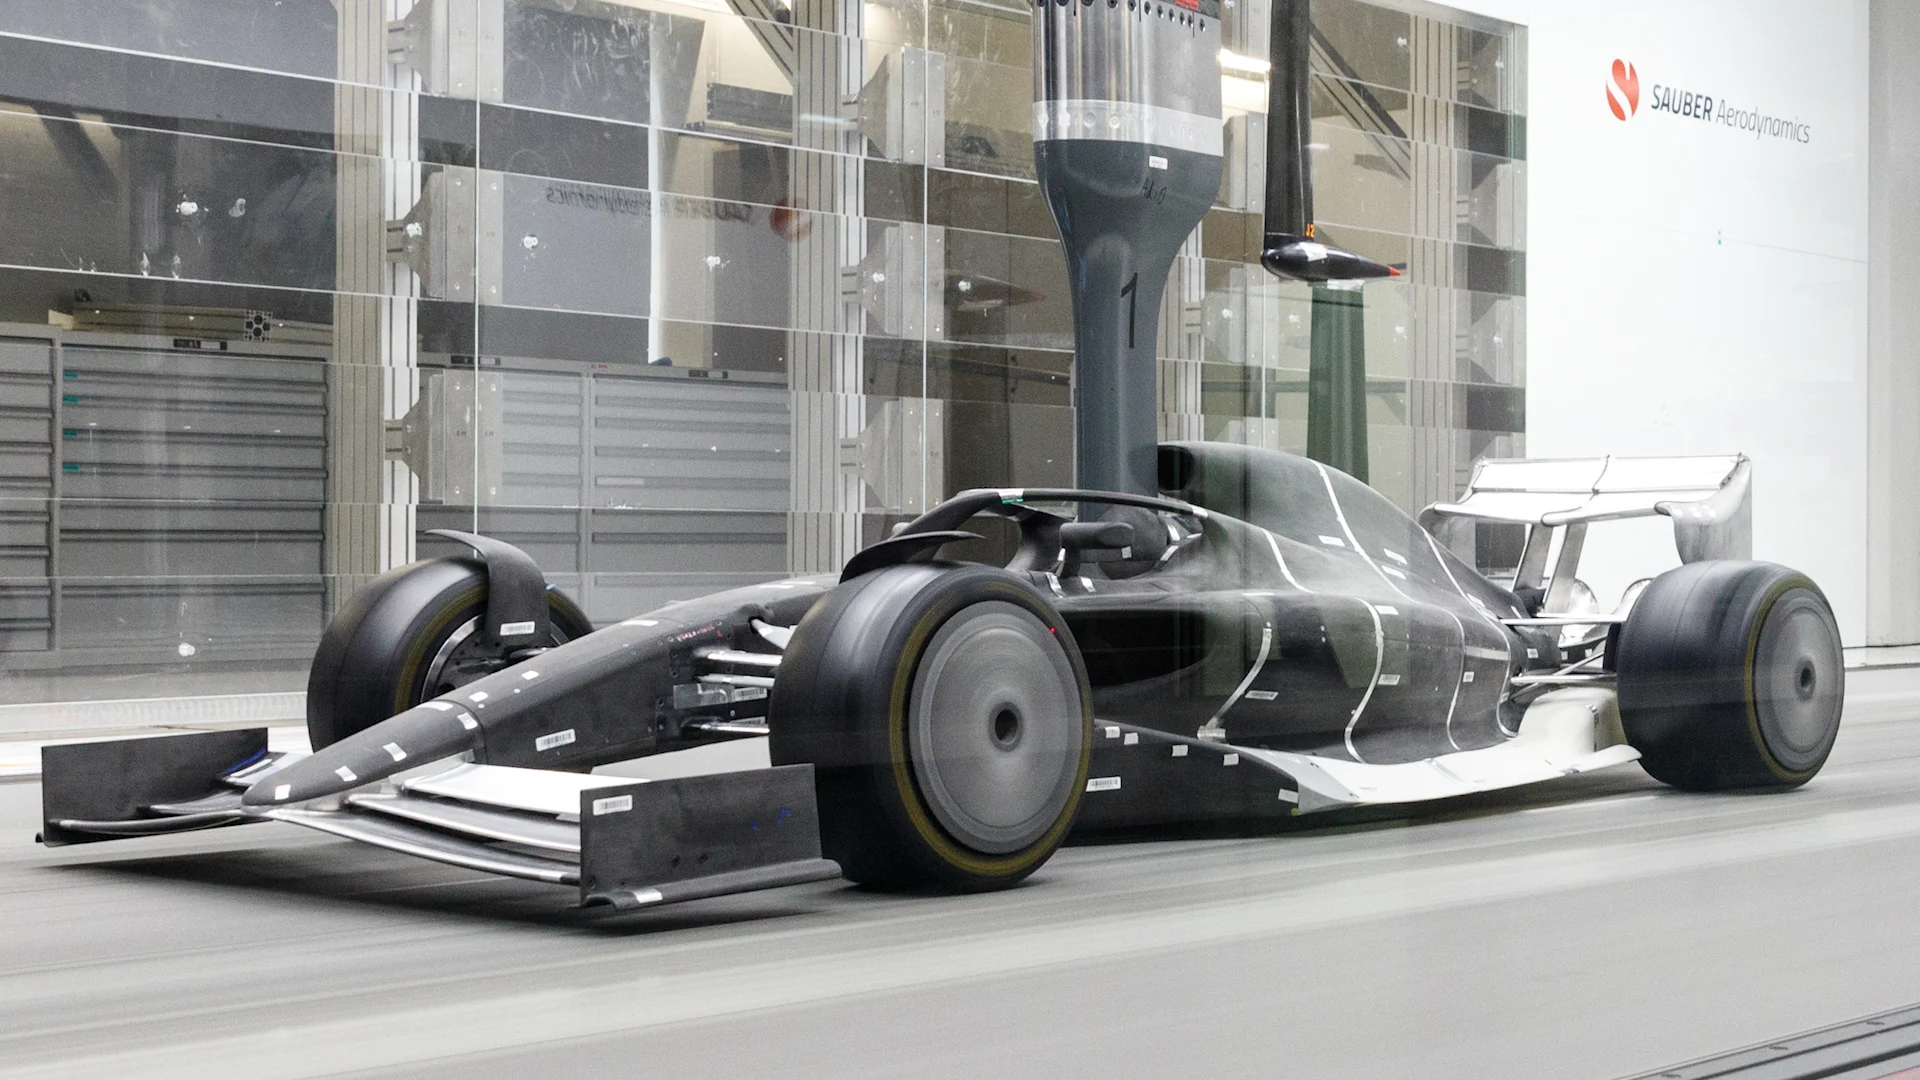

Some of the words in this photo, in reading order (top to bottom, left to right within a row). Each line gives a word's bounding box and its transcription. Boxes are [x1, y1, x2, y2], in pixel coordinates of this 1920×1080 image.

[1651, 84, 1713, 121] SAUBER
[1715, 99, 1811, 144] Aerodynamics
[1120, 272, 1138, 349] 1
